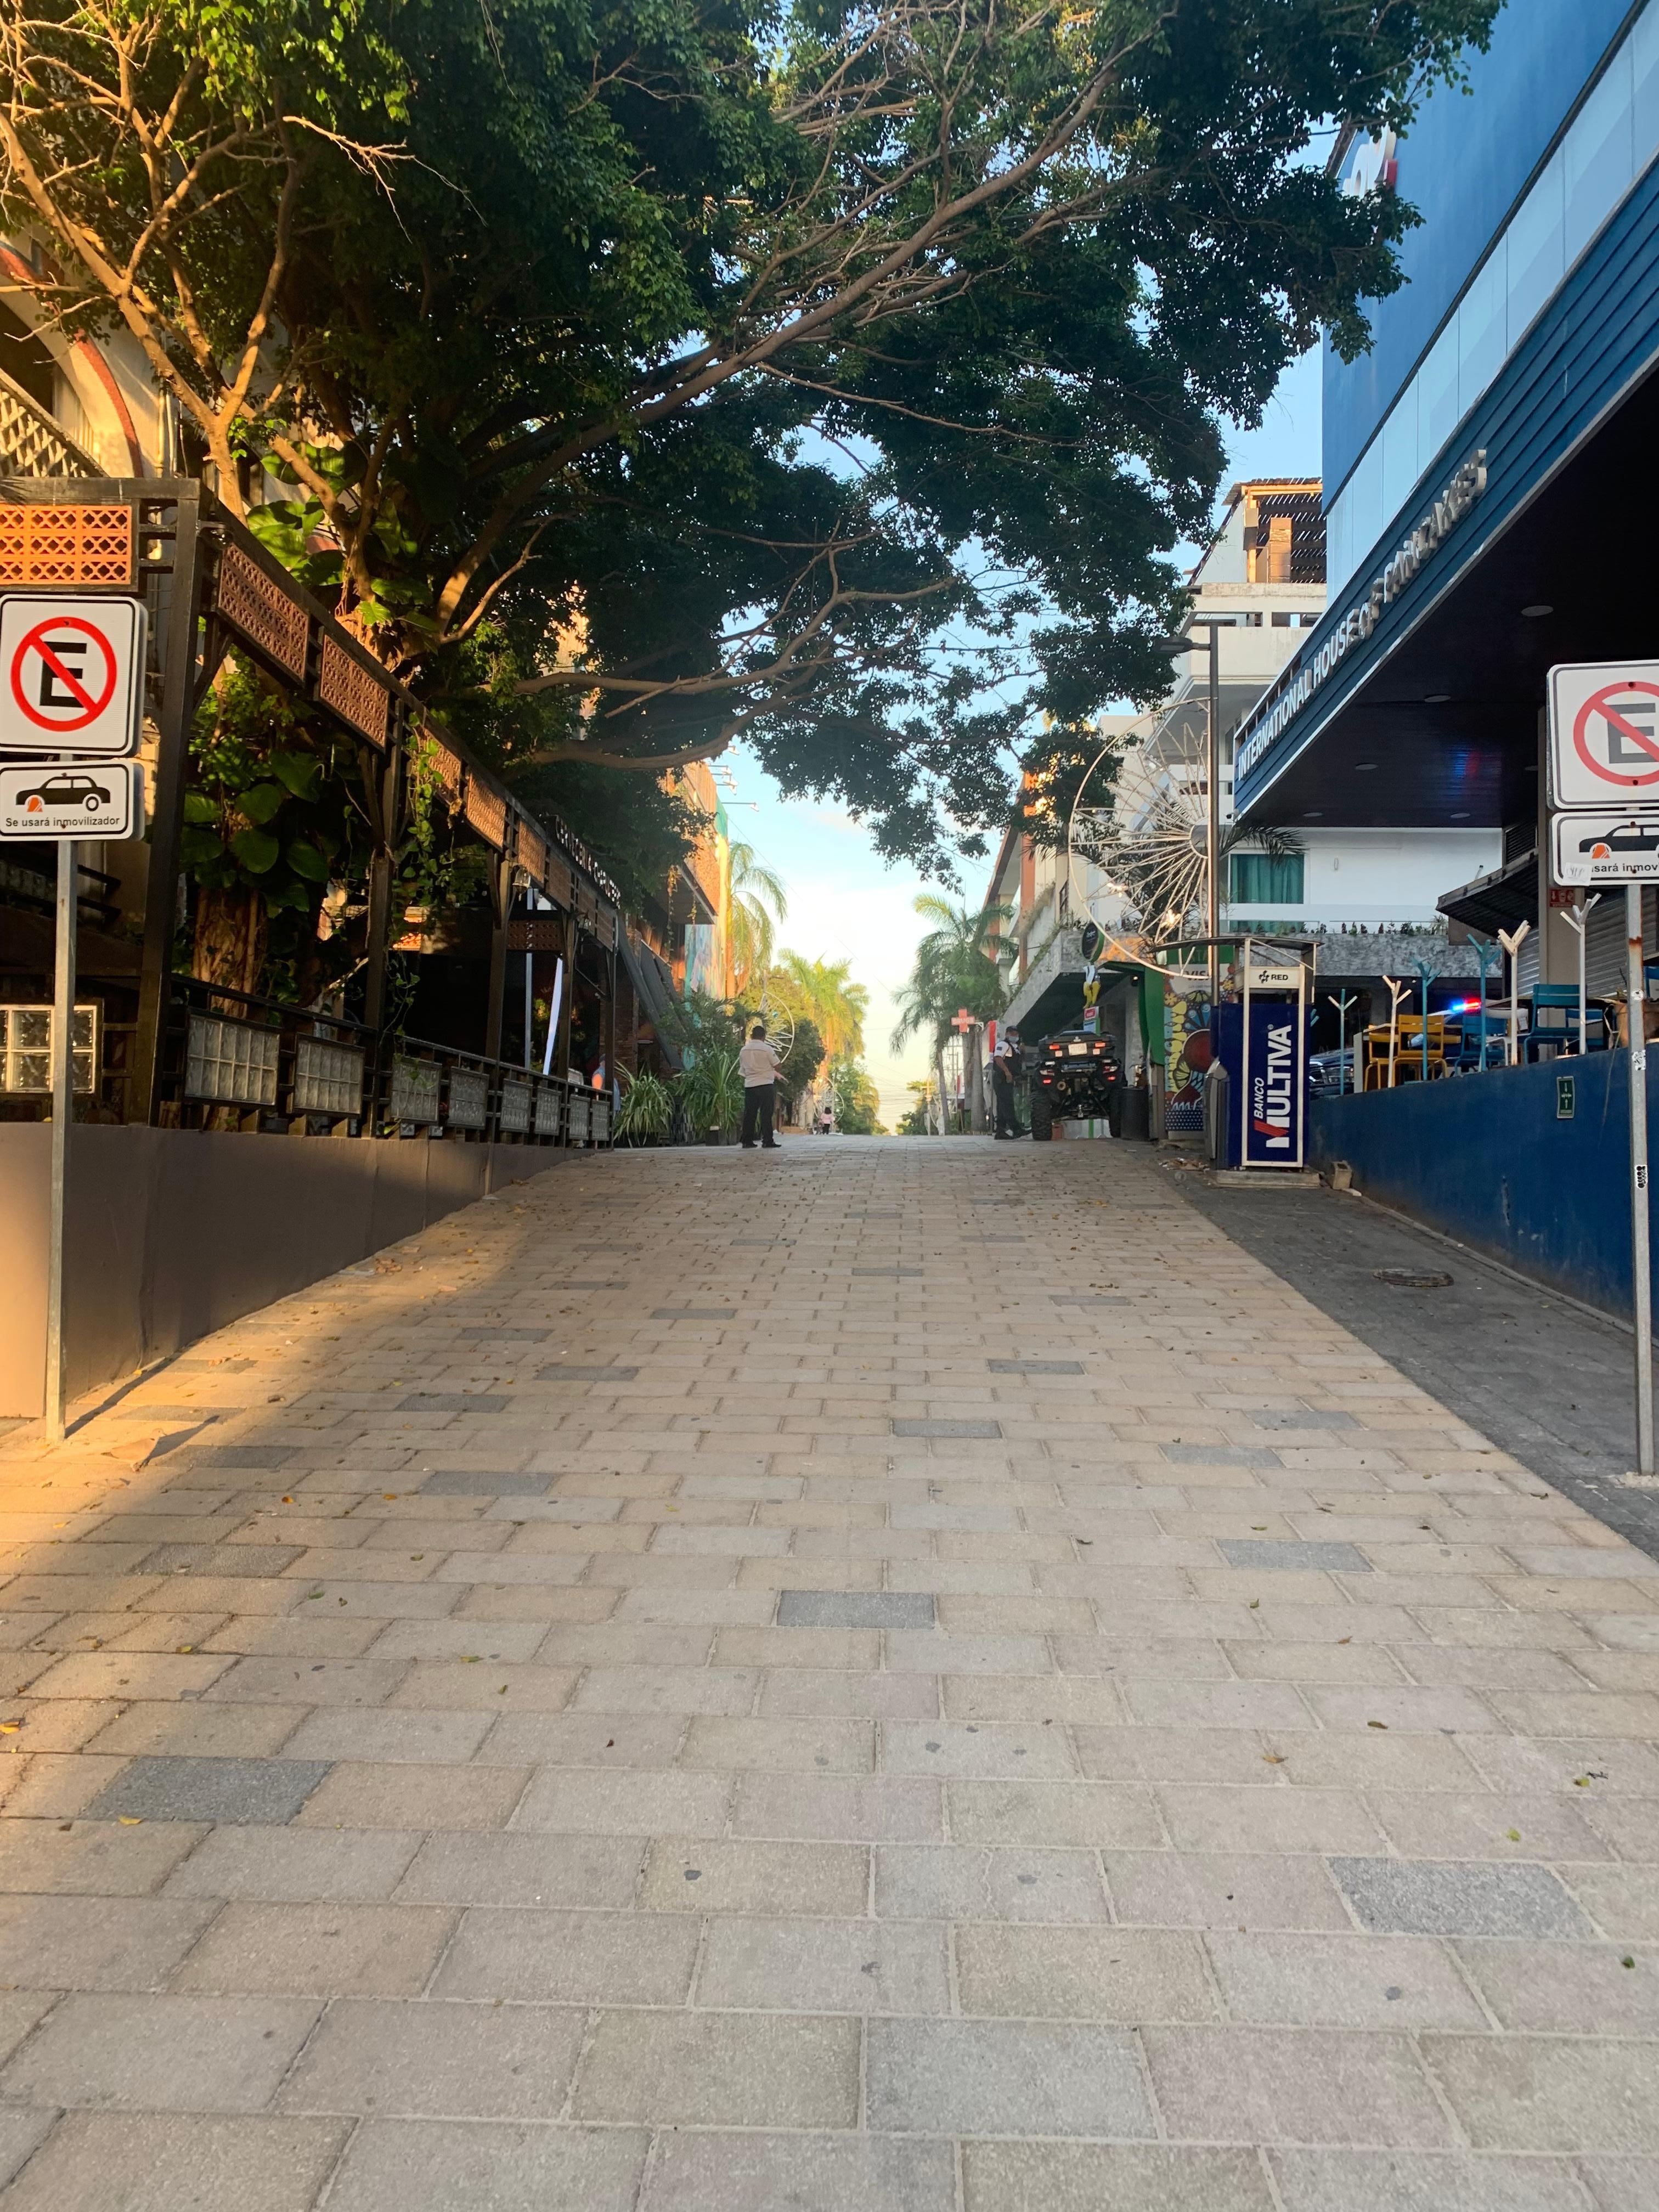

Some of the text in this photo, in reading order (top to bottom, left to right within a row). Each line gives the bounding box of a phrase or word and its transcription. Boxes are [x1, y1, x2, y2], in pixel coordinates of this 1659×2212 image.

[1238, 669, 1315, 782] INTERNATIONAL
[1313, 608, 1361, 690] HOUSE
[5, 816, 120, 827] Se usará inmovilizador
[1592, 863, 1619, 872] sará
[1623, 863, 1659, 872] inmov
[1254, 1077, 1265, 1119] BANCO
[1265, 1024, 1292, 1148] MULTIVA
